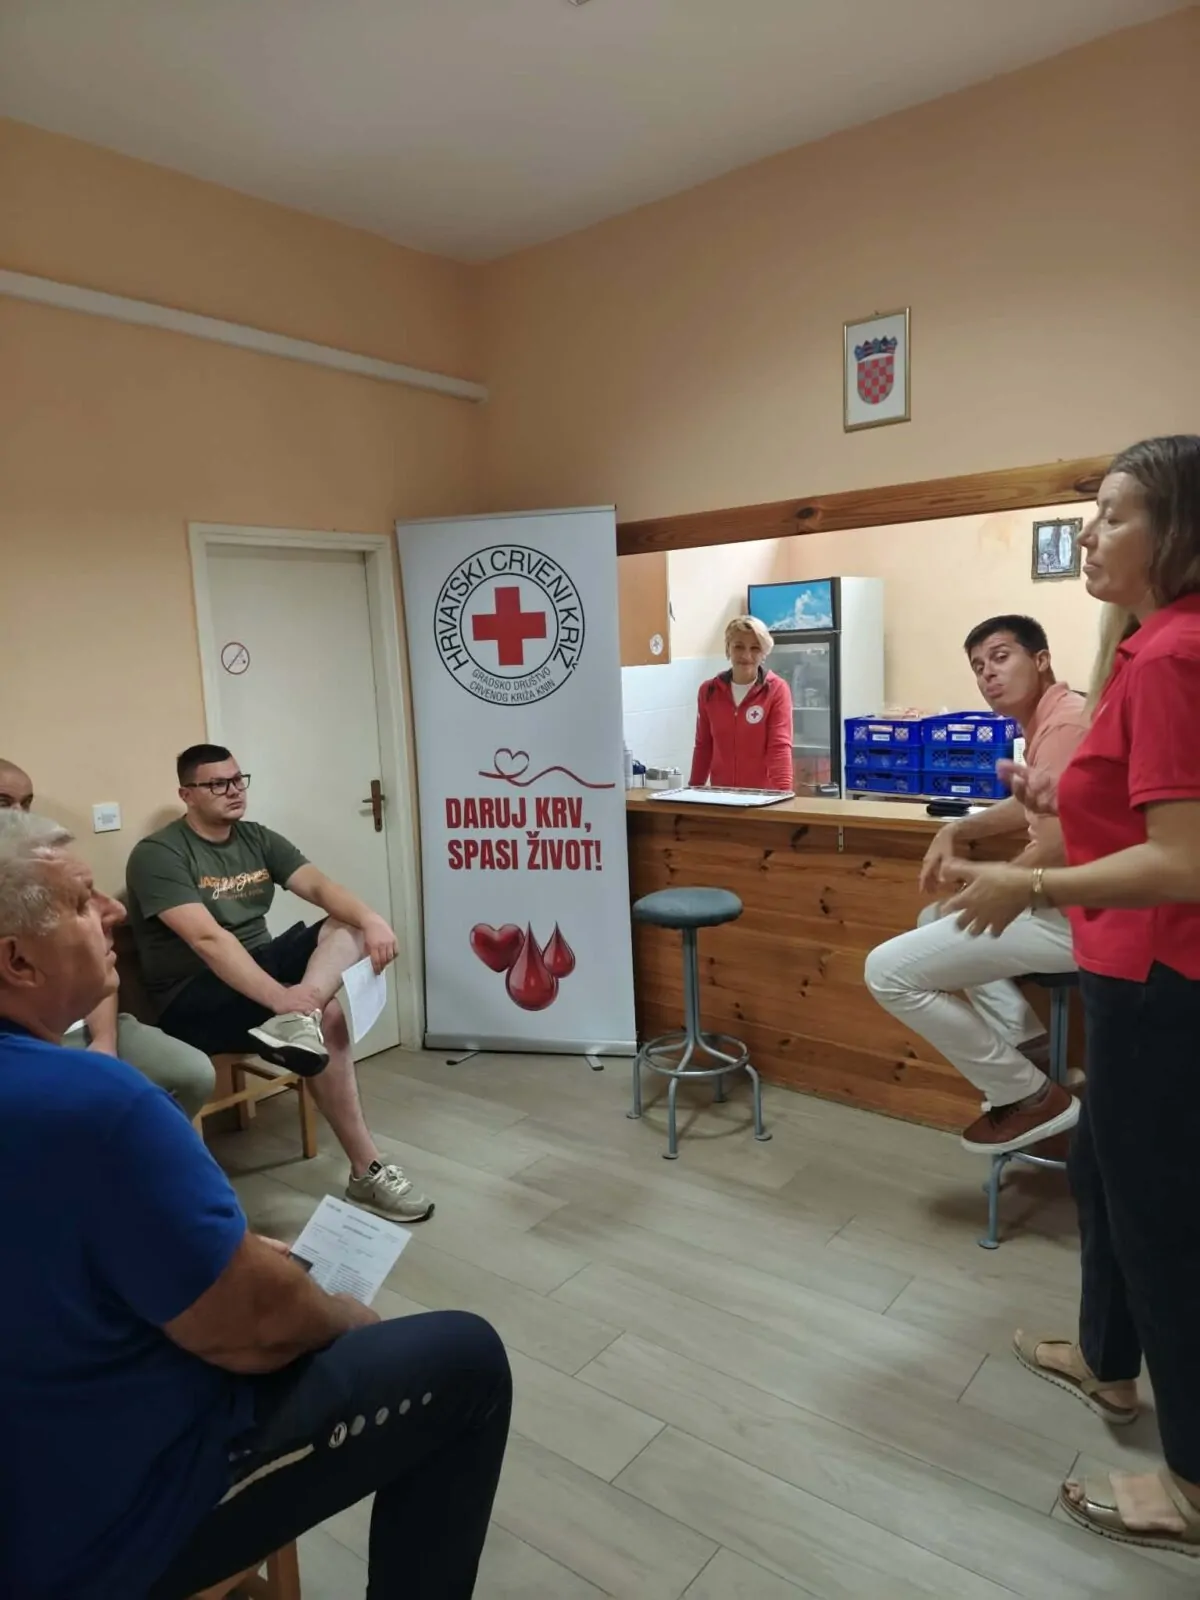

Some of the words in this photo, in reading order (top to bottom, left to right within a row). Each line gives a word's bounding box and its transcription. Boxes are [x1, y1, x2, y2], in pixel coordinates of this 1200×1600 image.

[438, 558, 487, 671] HRVATSKI
[490, 549, 574, 603] CRVENI
[552, 606, 580, 671] KRIŽ
[469, 680, 509, 703] CRVENOG
[510, 690, 536, 703] KRIŽA
[536, 679, 556, 695] KNIN
[471, 668, 512, 691] GRADSKO
[513, 666, 551, 691] DRUŠTVO
[445, 796, 527, 829] DARUJ
[535, 796, 592, 833] KRV,
[447, 839, 519, 870] SPASI
[526, 831, 603, 871] ŽIVOT!
